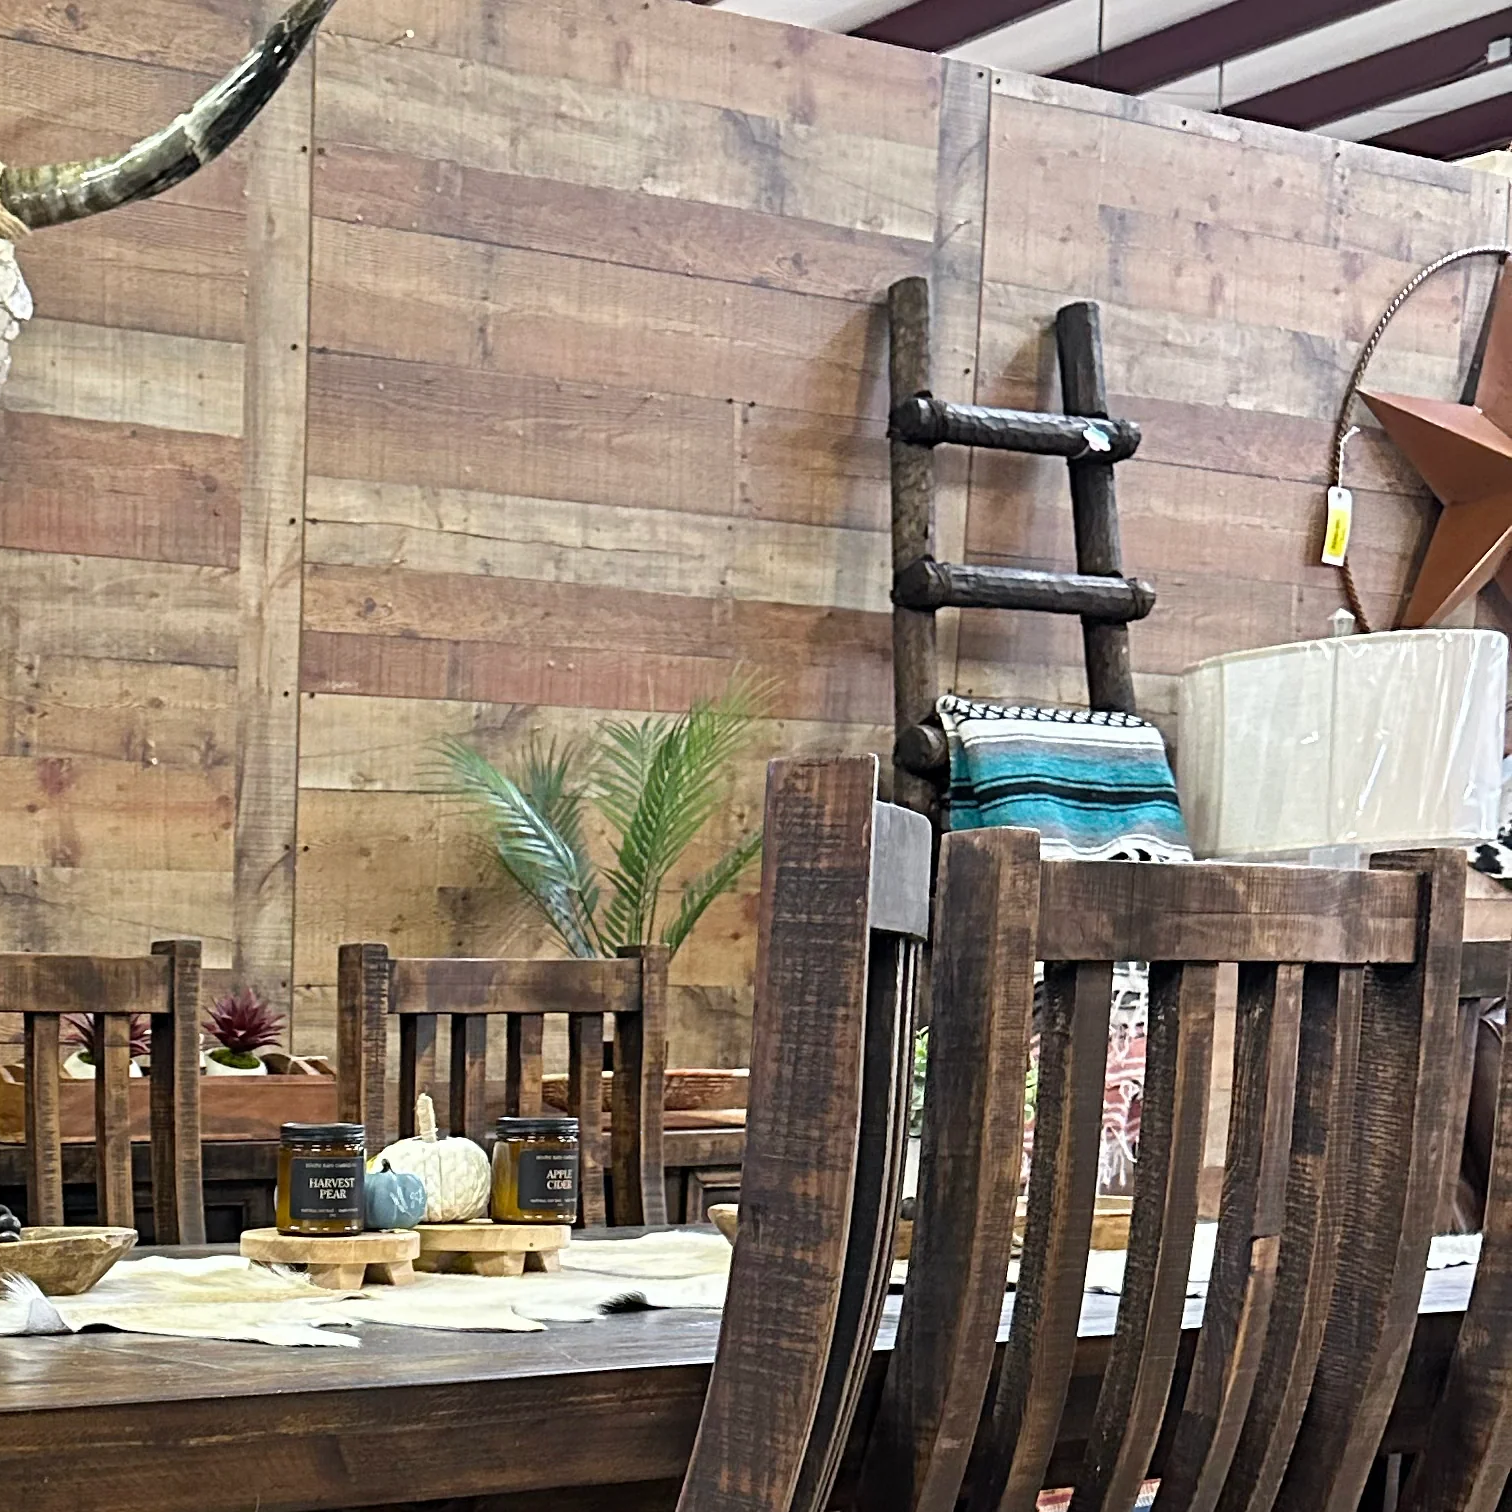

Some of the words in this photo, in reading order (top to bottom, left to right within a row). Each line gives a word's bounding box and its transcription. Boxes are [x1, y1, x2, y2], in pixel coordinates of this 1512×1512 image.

[546, 1169, 573, 1179] APPLE
[309, 1177, 355, 1189] HARVEST
[546, 1179, 573, 1190] CIDER
[319, 1188, 347, 1200] PEAR
